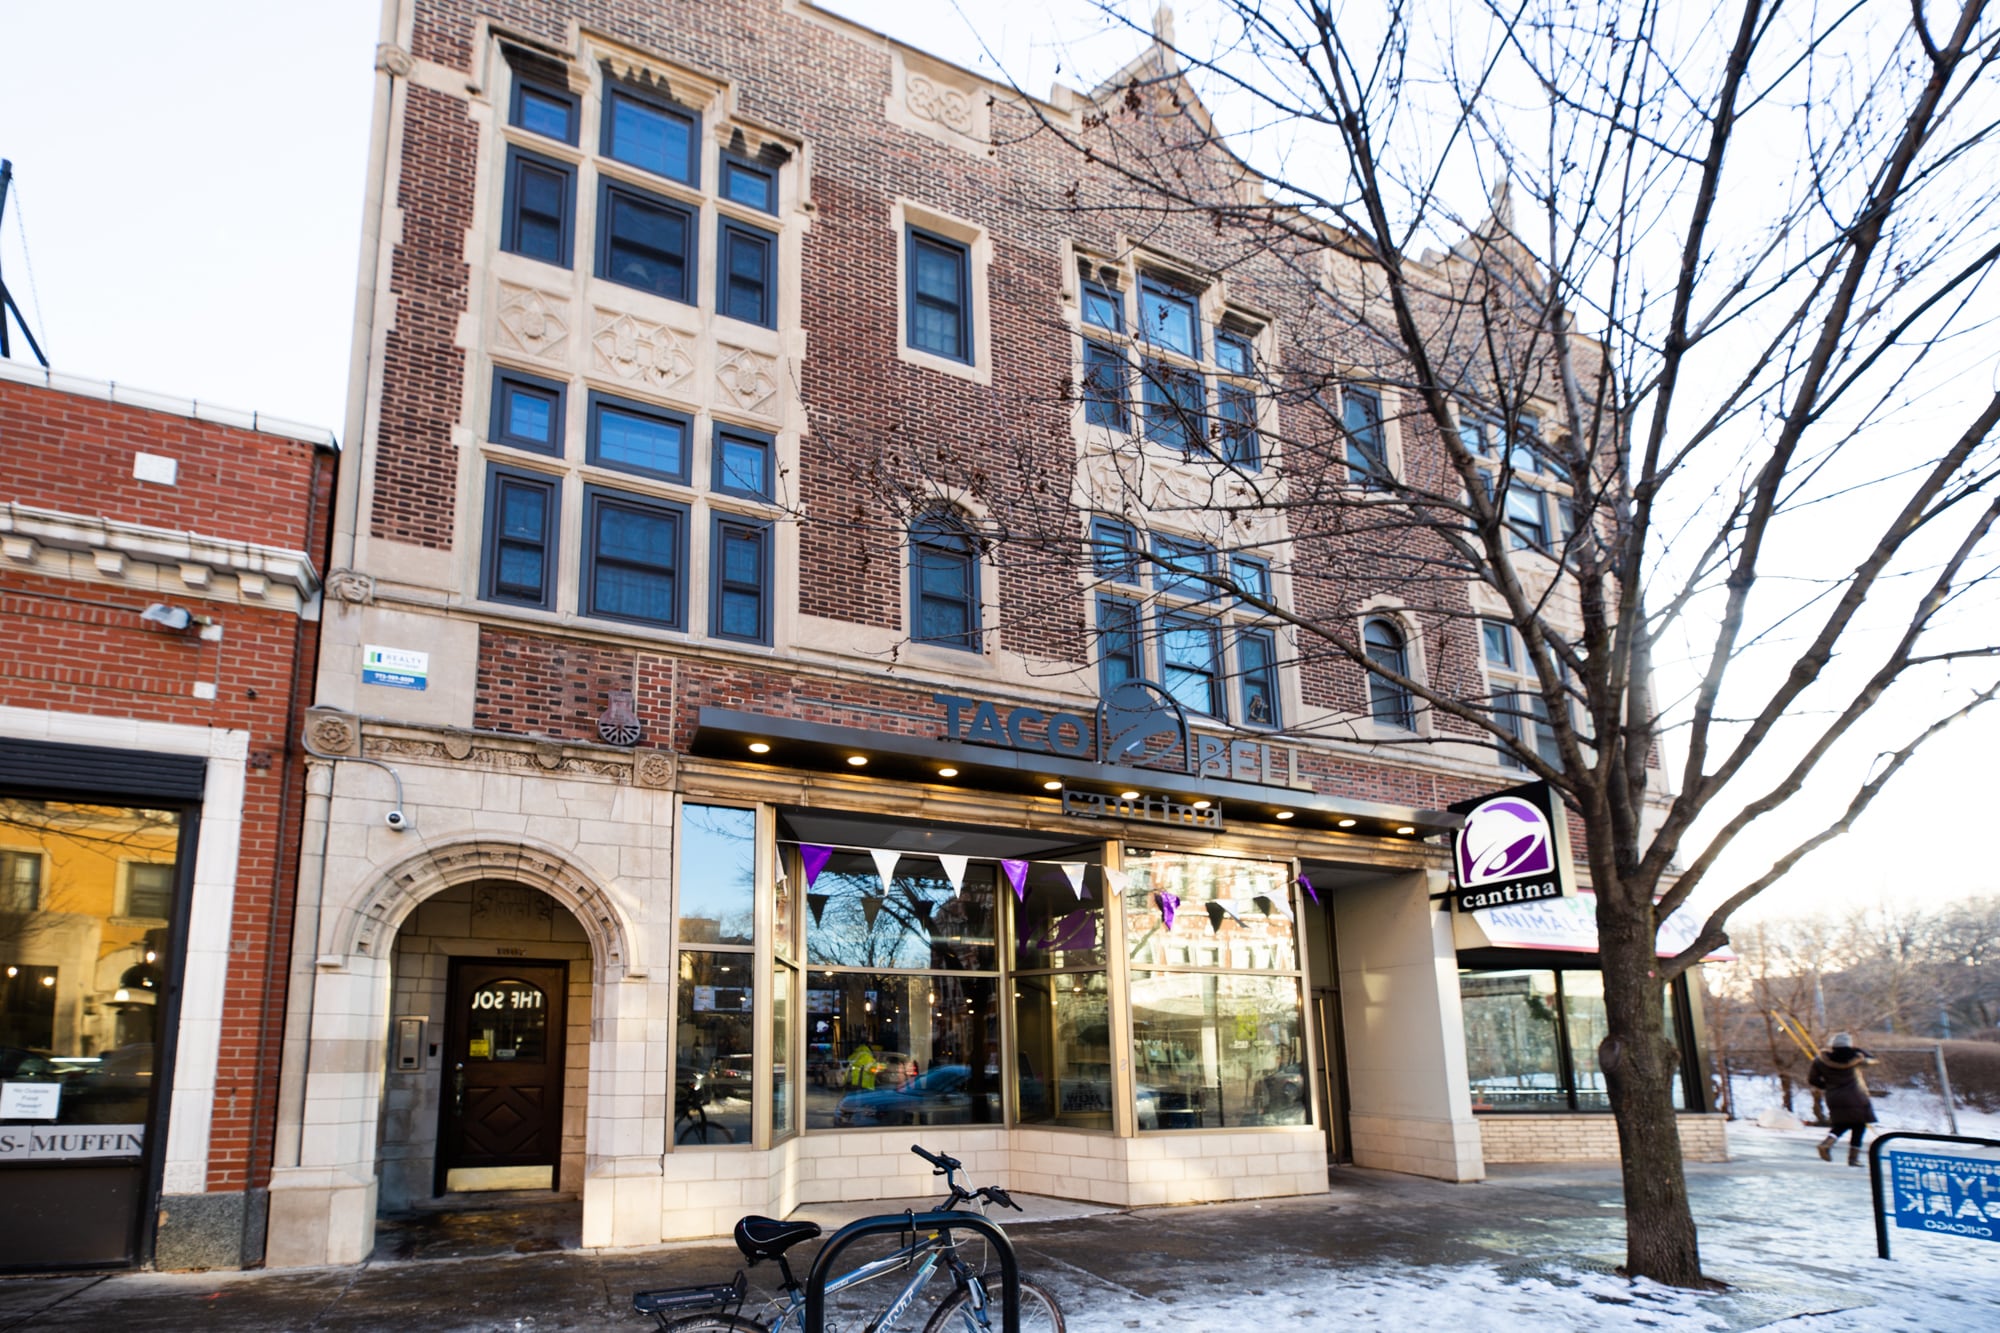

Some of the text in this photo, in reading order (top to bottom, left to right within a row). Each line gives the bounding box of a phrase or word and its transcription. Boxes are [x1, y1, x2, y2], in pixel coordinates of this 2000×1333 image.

[386, 655, 421, 664] REALTY
[933, 693, 1313, 790] TACO BELL
[1063, 790, 1222, 828] cantina
[1462, 882, 1557, 909] cantina
